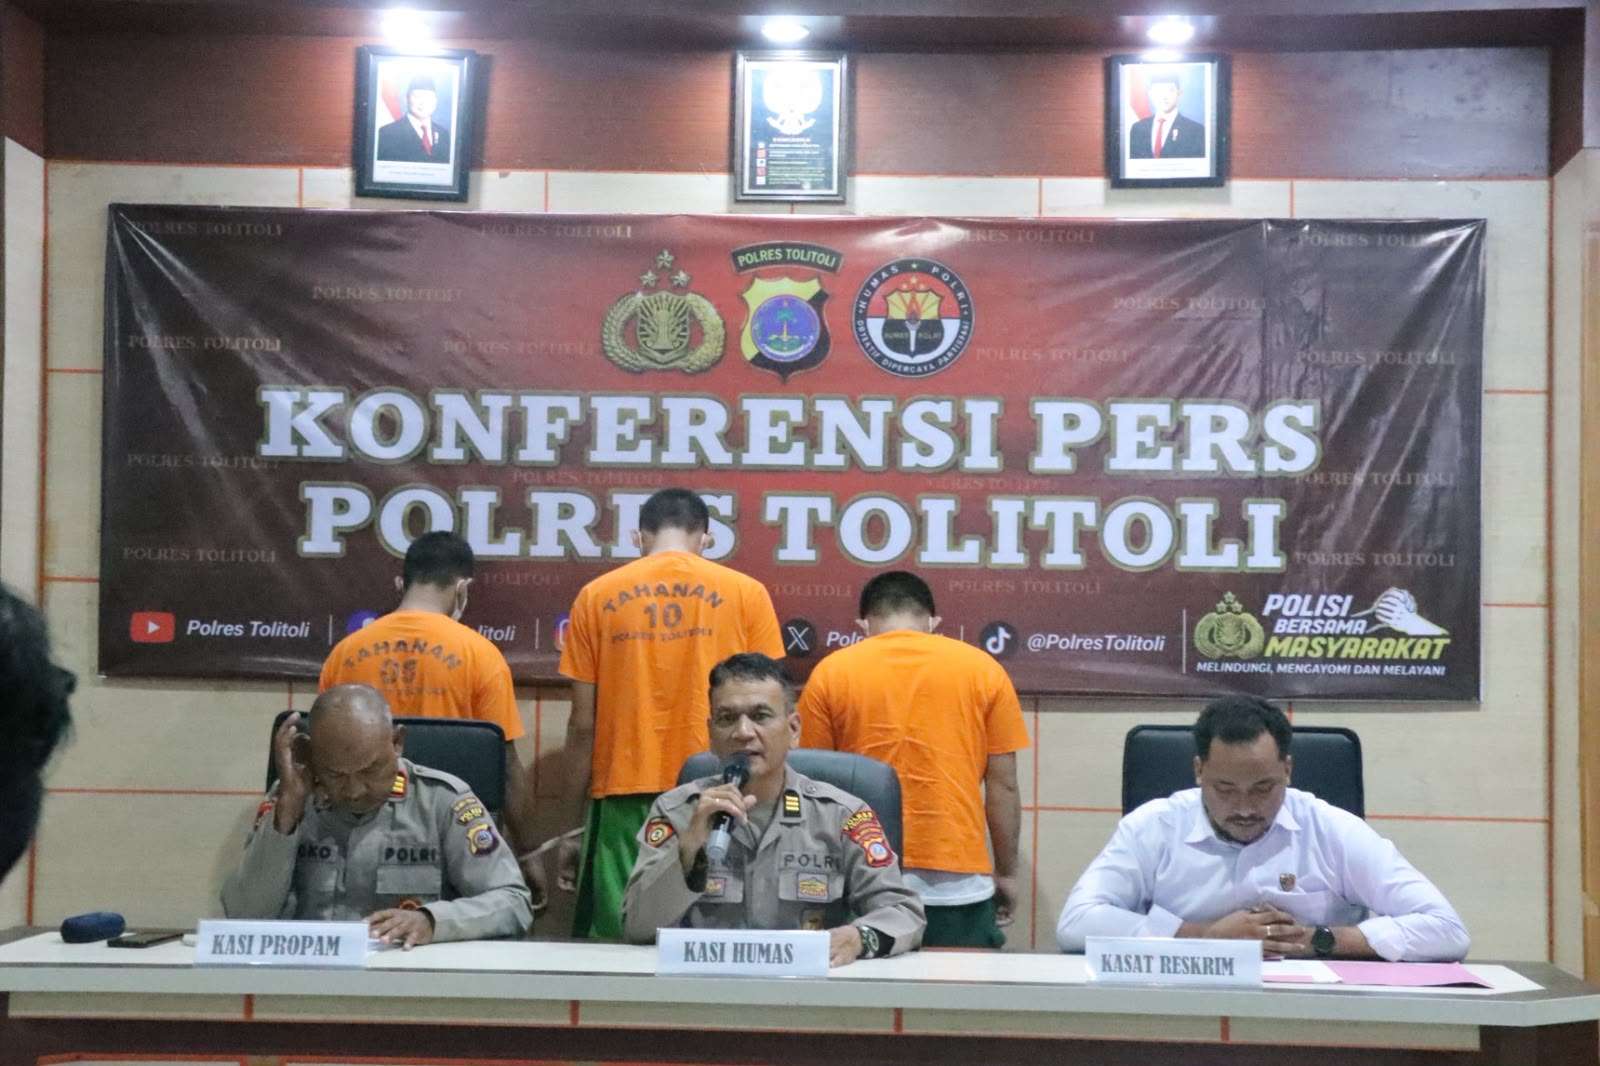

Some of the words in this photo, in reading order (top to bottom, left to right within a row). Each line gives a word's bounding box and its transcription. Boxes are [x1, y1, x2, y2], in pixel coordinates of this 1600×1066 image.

[737, 248, 783, 267] POLRES
[786, 248, 836, 268] TOLITOLI
[858, 265, 899, 309] HUMAS
[931, 266, 969, 309] POLRI
[1296, 350, 1367, 365] POLRES
[1374, 350, 1456, 365] TOLITOLI
[258, 388, 1002, 472] KONFERENSI
[1029, 398, 1320, 475] PERS
[764, 495, 1284, 569] TOLITOLI
[122, 546, 191, 561] POLRES
[197, 546, 277, 563] TOLITOLI
[1294, 550, 1367, 566] POLRES
[1371, 551, 1456, 568] TOLITOLI
[602, 583, 724, 612] TAHANAN
[1261, 594, 1354, 617] POLISI
[643, 602, 683, 629] 10
[186, 619, 244, 637] Polres
[249, 620, 311, 638] Tolitoli
[478, 624, 516, 642] litoli
[1273, 619, 1368, 635] BERSAMA
[826, 630, 865, 648] Polr
[1027, 633, 1166, 652] @PolresTolitoli
[1263, 636, 1452, 660] MASYARAKAT
[342, 639, 463, 669] TAHANAN
[1196, 662, 1274, 675] MELINDUNGI,
[1276, 663, 1351, 675] MENGAYOMI
[1353, 664, 1381, 675] DAN
[1383, 664, 1446, 676] MELAYANI
[384, 847, 437, 862] POLRI
[211, 934, 256, 955] KASI
[259, 934, 341, 956] PROPAM
[683, 941, 726, 963] KASI
[731, 942, 794, 965] HUMAS
[1101, 953, 1154, 974] KASAT
[1159, 955, 1236, 976] RESKRIM
